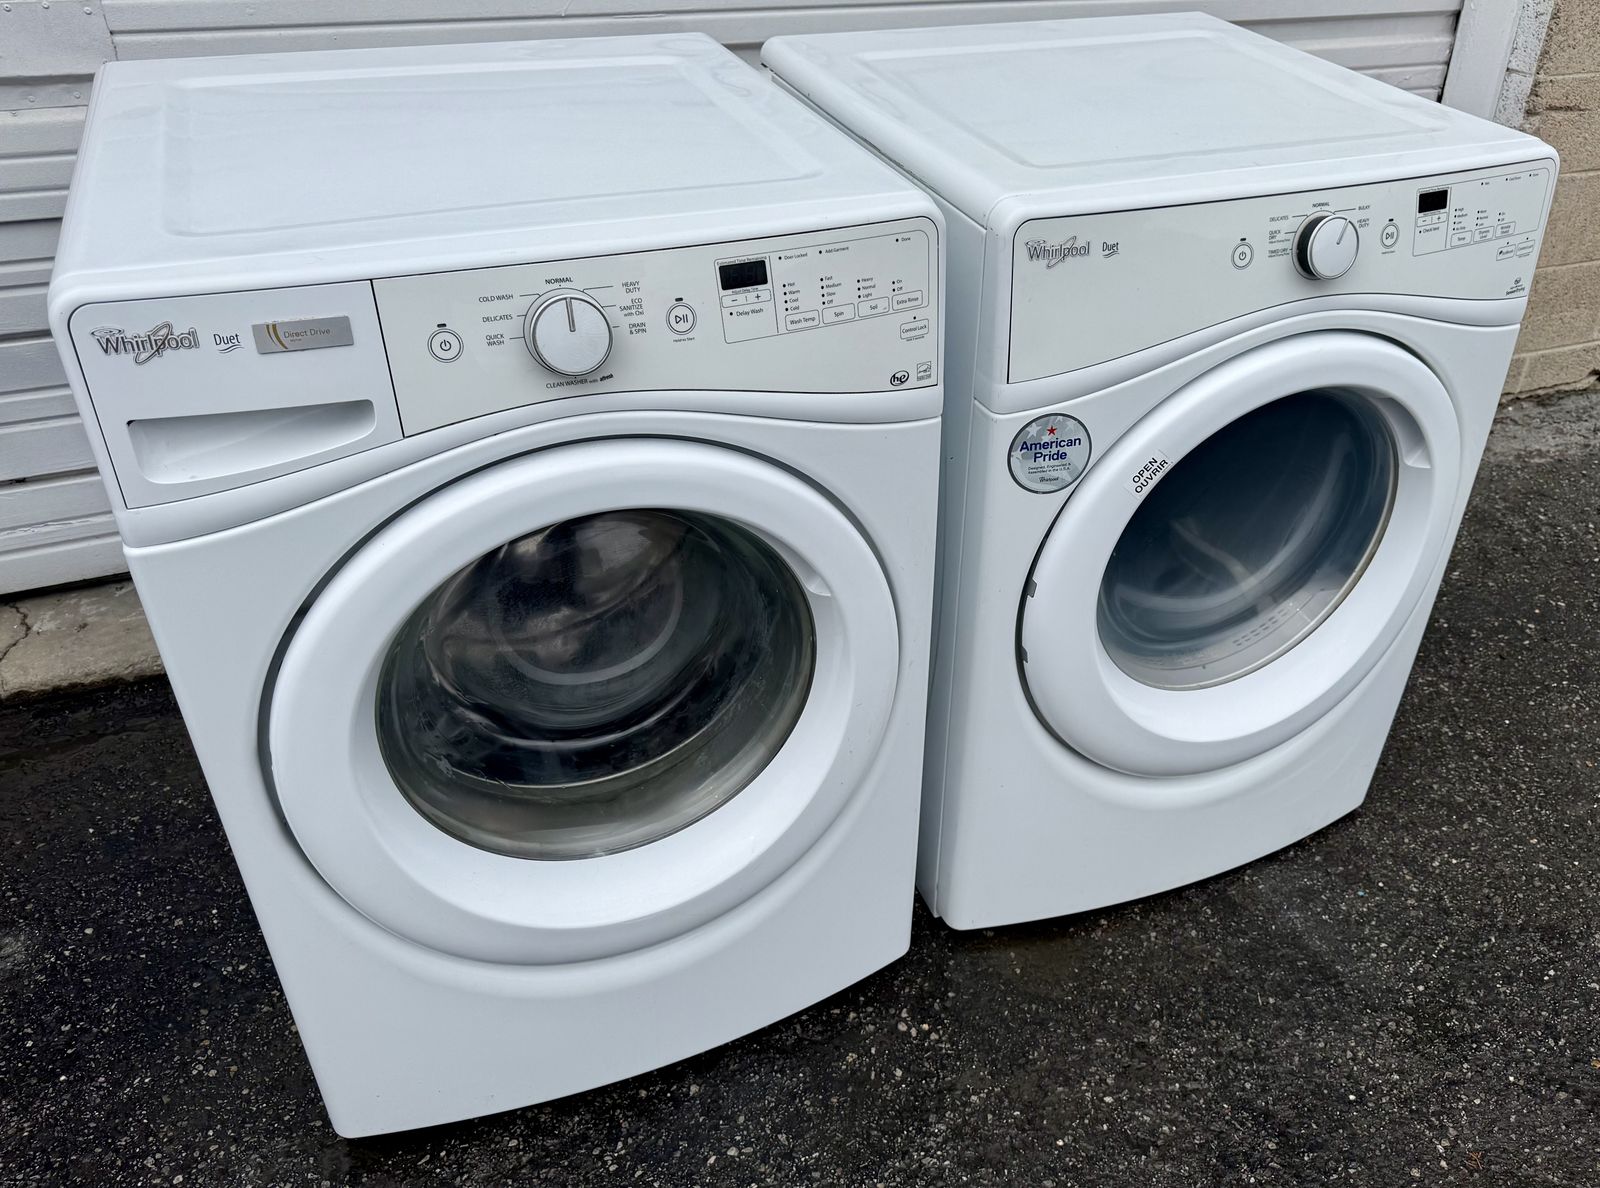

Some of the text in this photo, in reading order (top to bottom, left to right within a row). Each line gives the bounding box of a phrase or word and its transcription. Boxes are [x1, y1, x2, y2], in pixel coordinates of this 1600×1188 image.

[1026, 239, 1119, 265] Whirlpool Duet
[545, 277, 573, 285] NORMAL
[478, 295, 495, 303] COLD
[620, 304, 643, 312] SANITIZE
[482, 314, 513, 322] DELICATES
[284, 328, 331, 338] Direct Drive
[902, 326, 917, 334] Control
[95, 324, 241, 361] Whirlpool Duet
[546, 381, 564, 389] CLEAN
[1020, 437, 1081, 452] American
[1034, 450, 1067, 463] Pride
[1132, 457, 1158, 483] OPEN
[1135, 460, 1168, 493] OUVRIR
